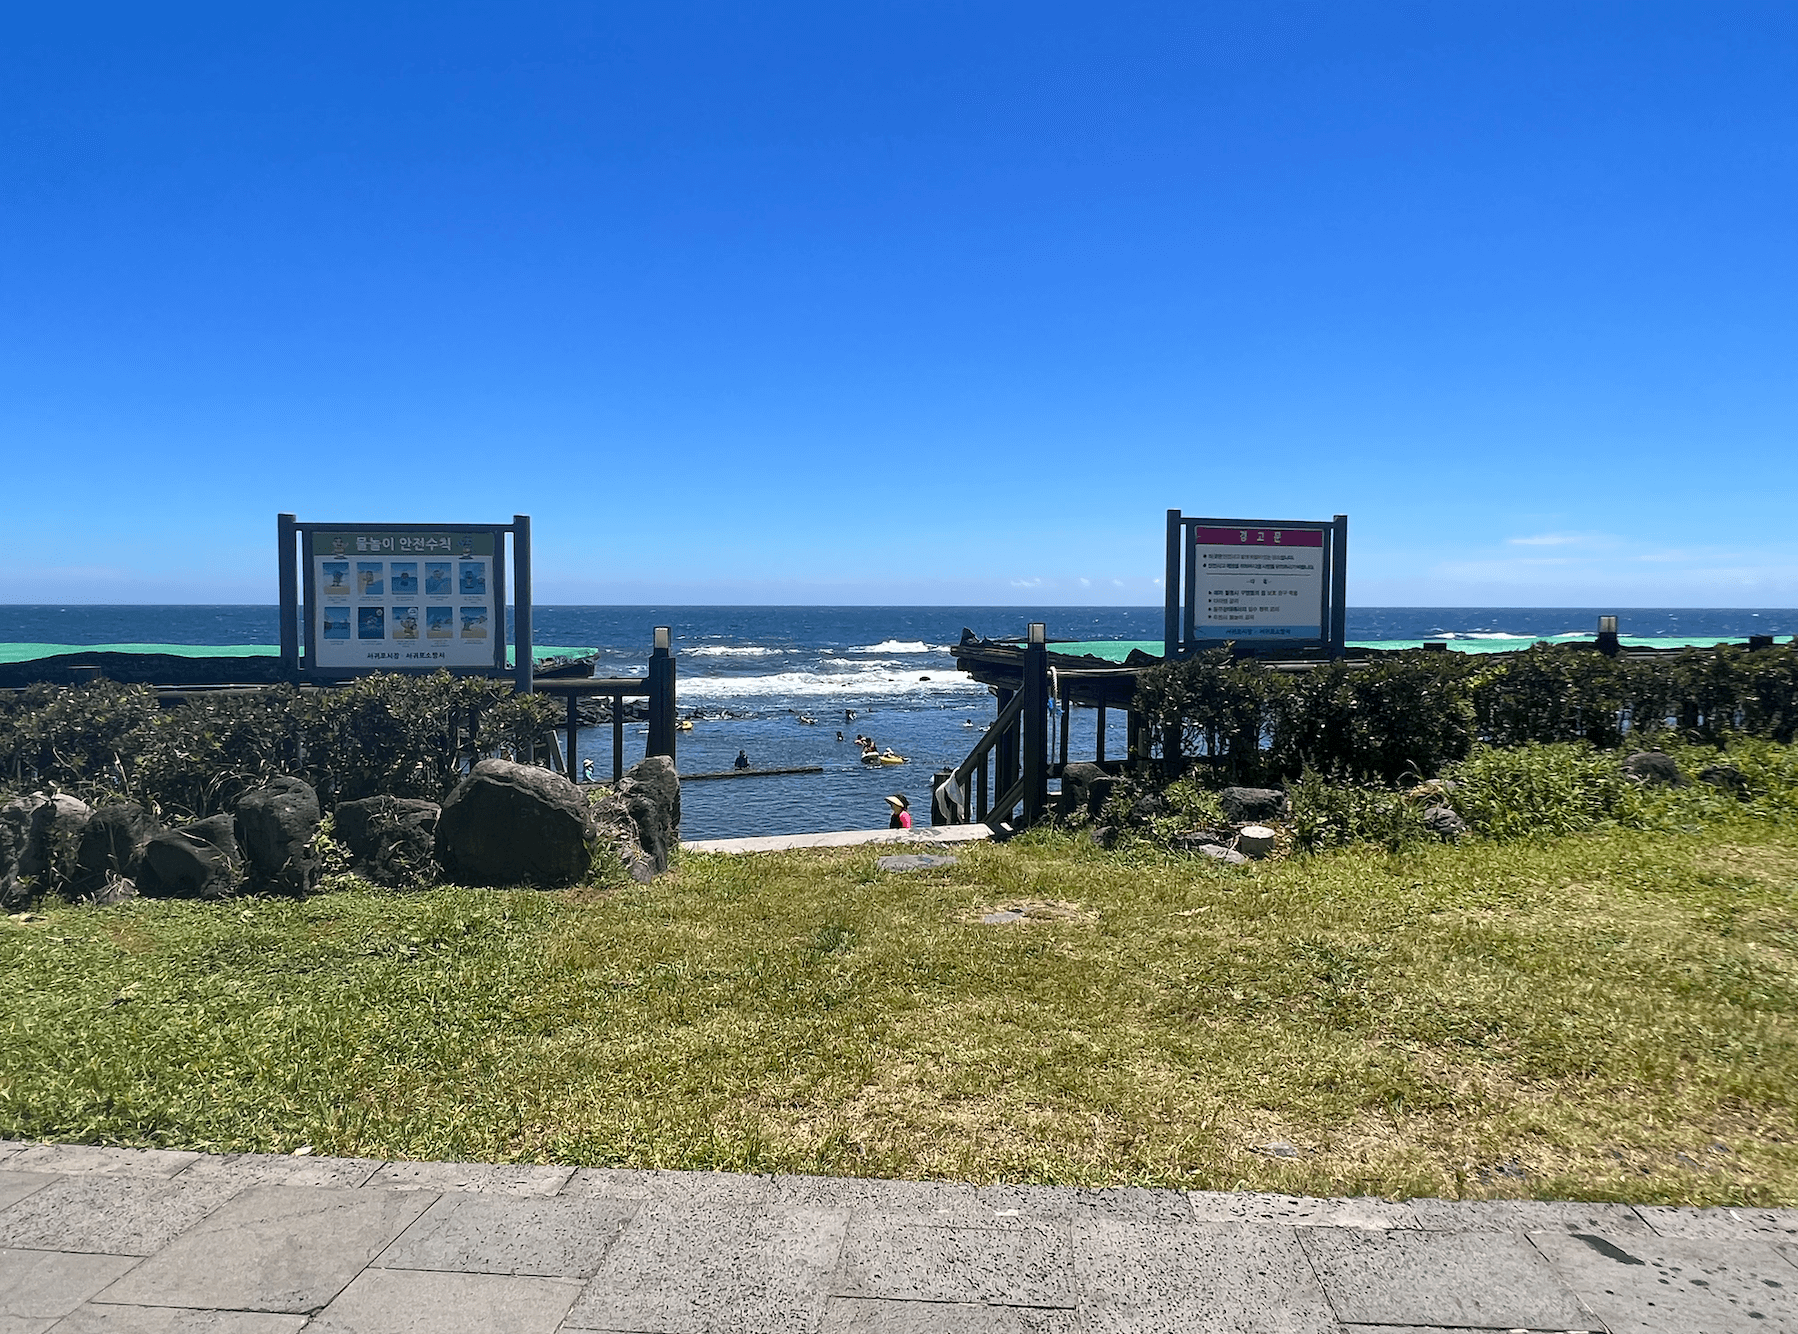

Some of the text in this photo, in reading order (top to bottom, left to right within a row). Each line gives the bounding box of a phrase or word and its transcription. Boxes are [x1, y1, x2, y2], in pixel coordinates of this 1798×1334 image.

[356, 536, 452, 551] 물놀이 안전수칙
[367, 652, 446, 660] 서귀포시장 서귀포소방서
